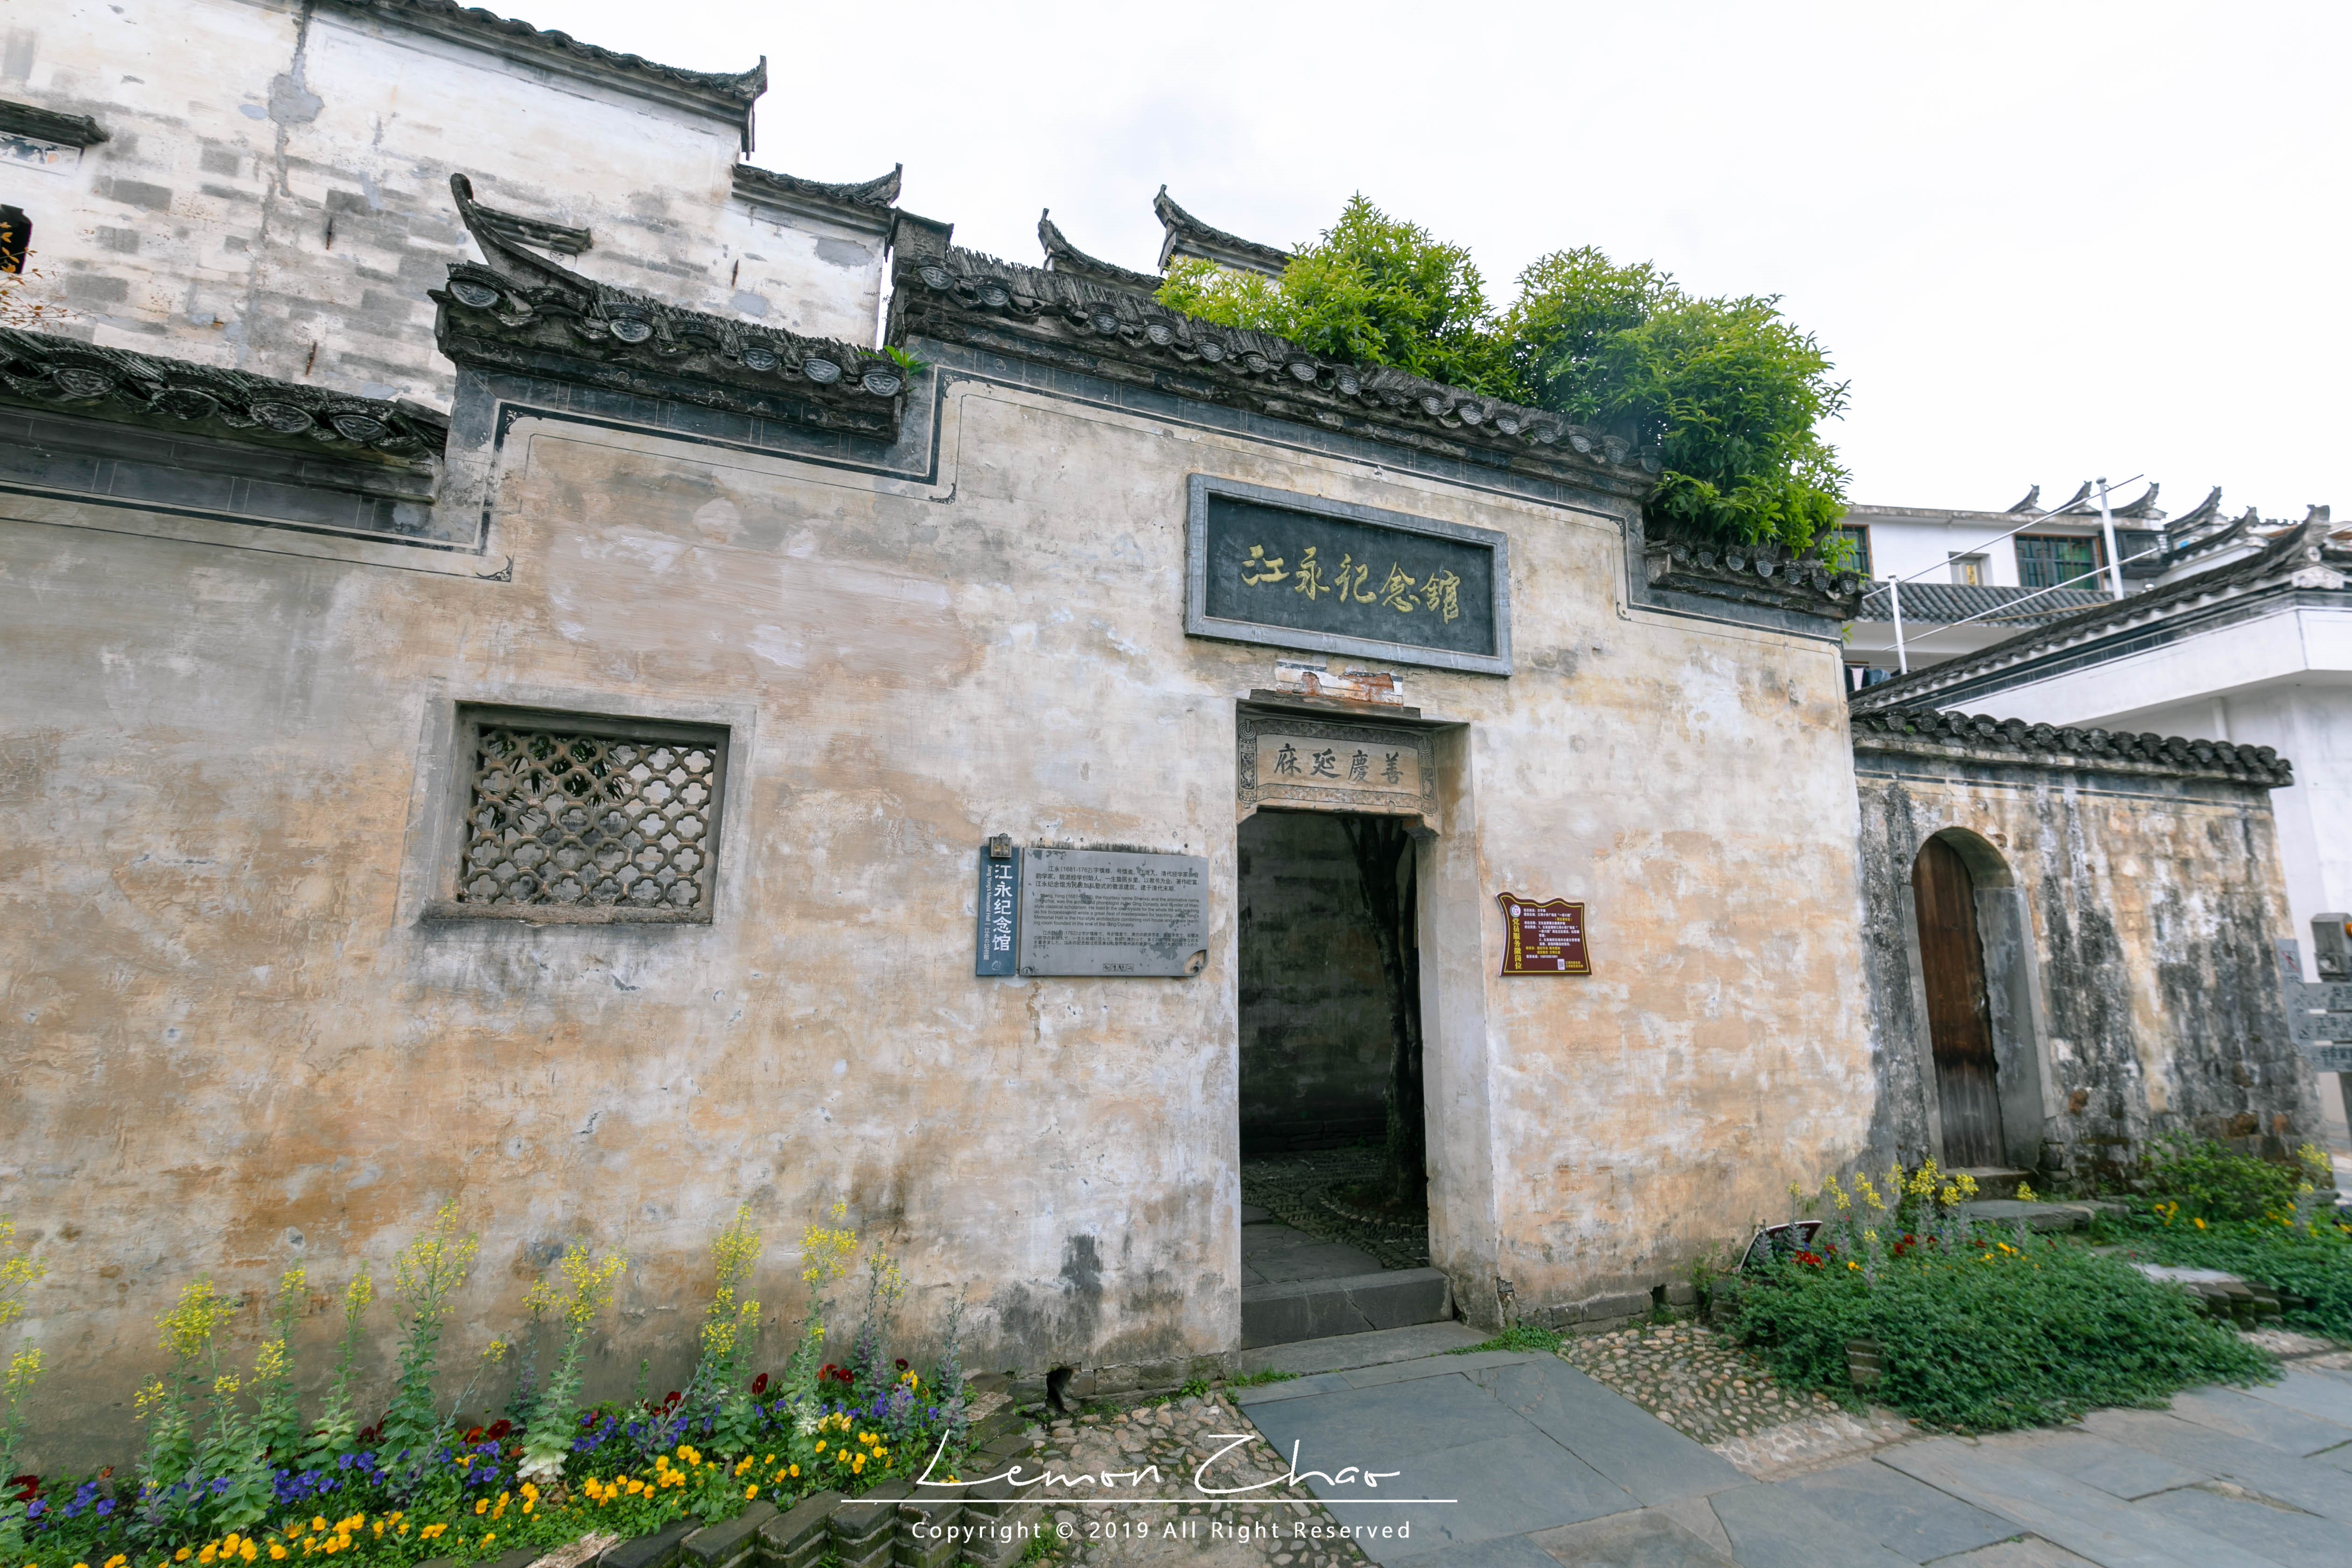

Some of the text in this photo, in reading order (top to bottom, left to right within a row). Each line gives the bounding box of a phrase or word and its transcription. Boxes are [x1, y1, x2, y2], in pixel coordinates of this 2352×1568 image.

[992, 864, 1013, 951] 江永纪念馆
[1512, 918, 1522, 970] 党员服务微岗位
